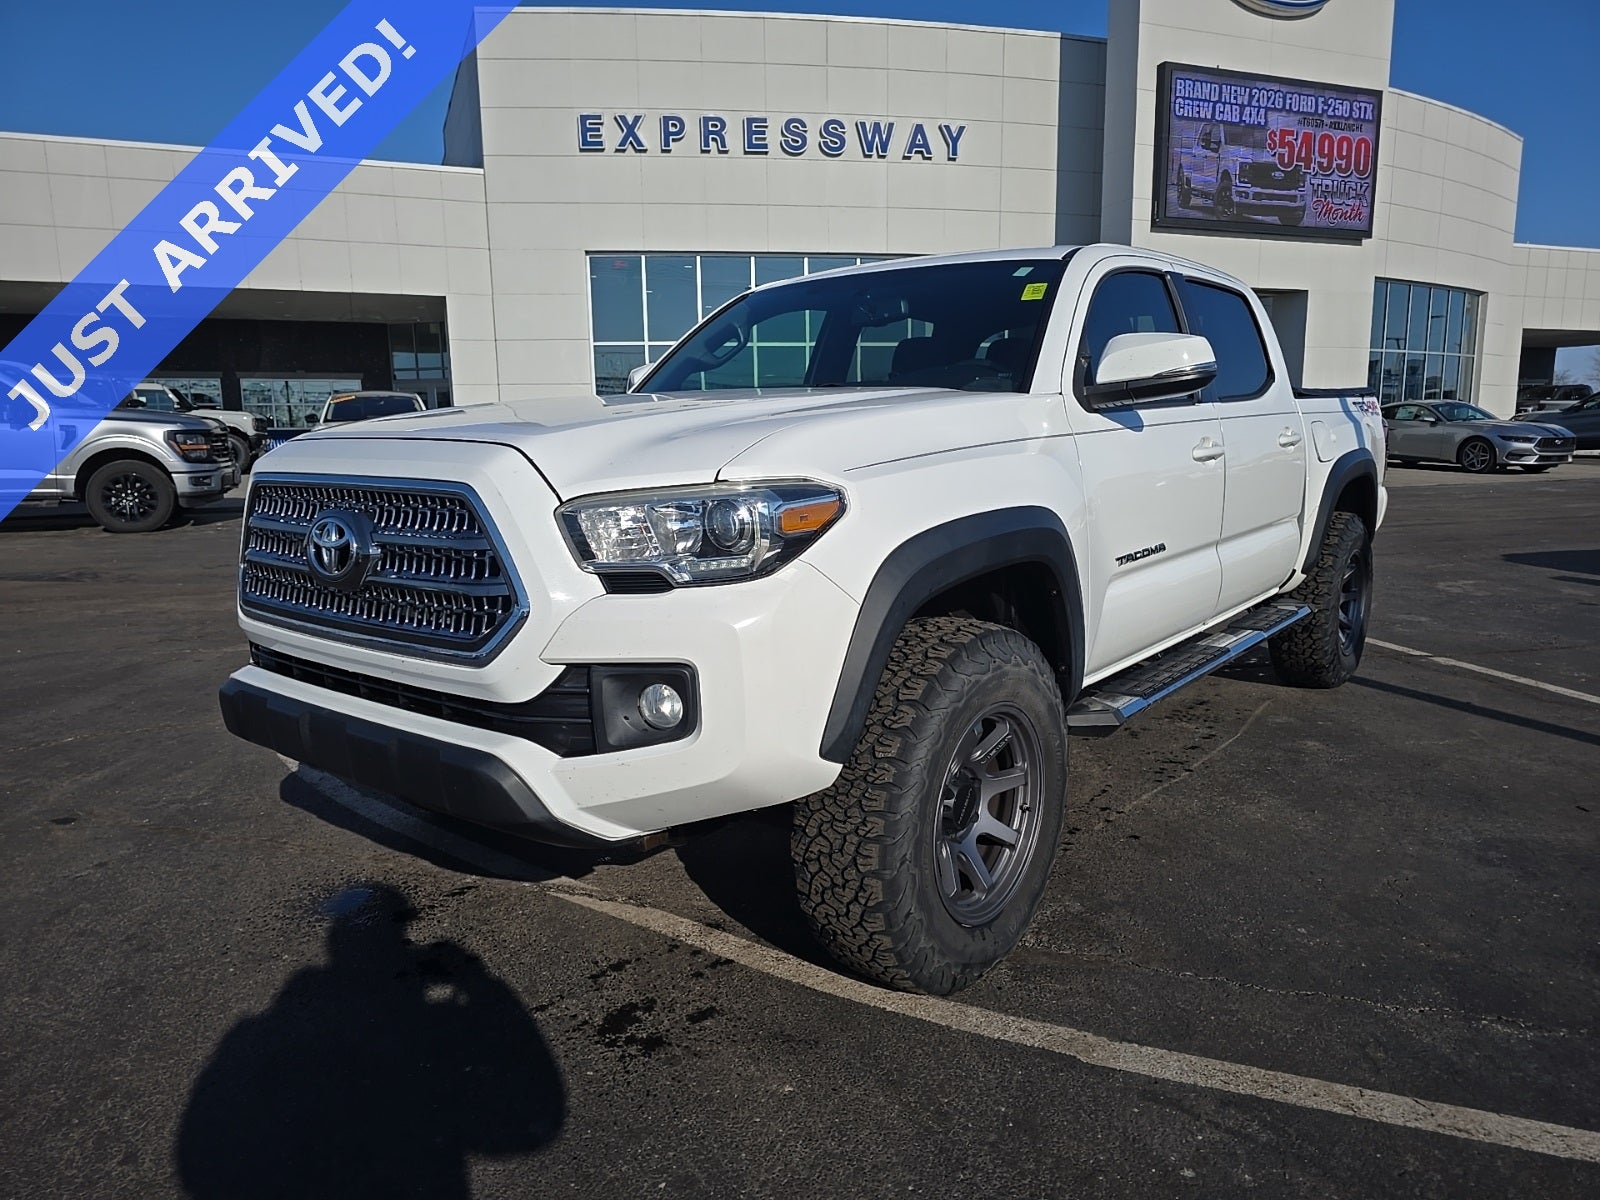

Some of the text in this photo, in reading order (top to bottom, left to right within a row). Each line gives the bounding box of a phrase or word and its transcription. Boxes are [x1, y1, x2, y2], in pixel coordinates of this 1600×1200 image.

[1175, 99, 1266, 126] CREW CAB 4X4
[1176, 79, 1373, 120] BRAND NEW 2026 FORD F-250 STX
[578, 113, 967, 161] EXPRESSWAY
[1267, 128, 1371, 177] $54,990
[1310, 178, 1370, 206] TRUCK
[1311, 199, 1366, 226] Month
[1115, 542, 1167, 567] TACOMA
